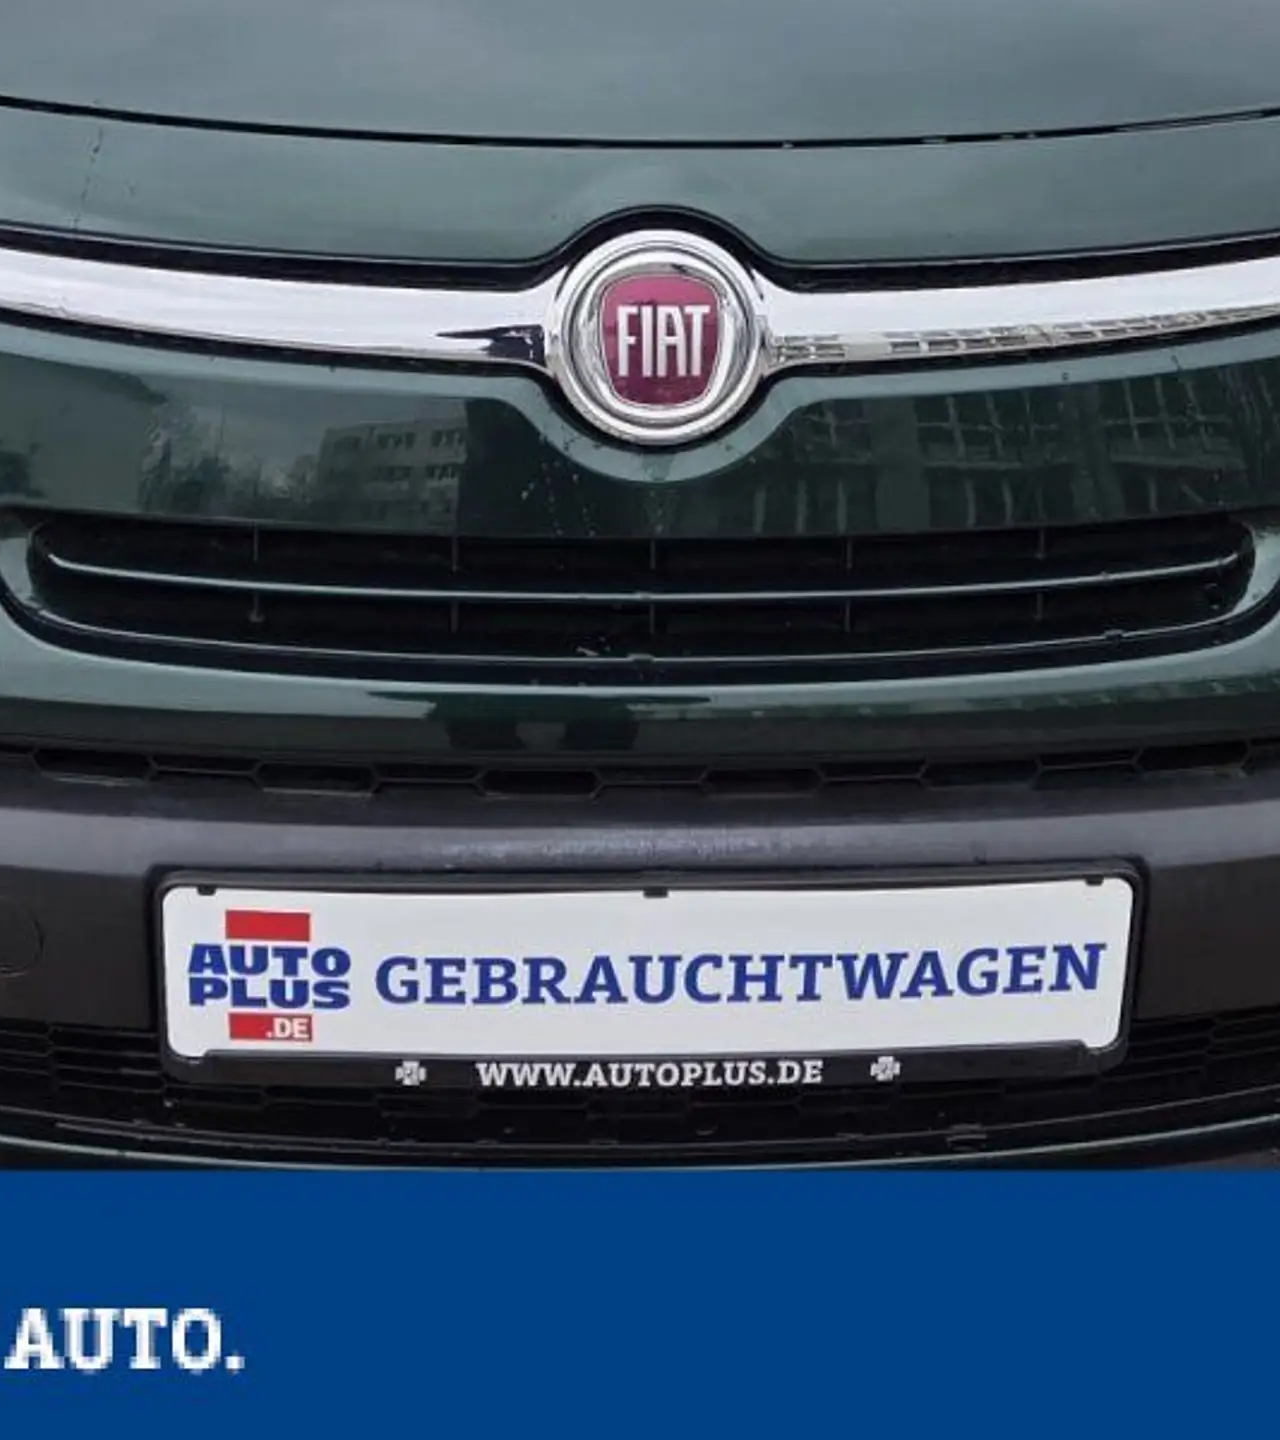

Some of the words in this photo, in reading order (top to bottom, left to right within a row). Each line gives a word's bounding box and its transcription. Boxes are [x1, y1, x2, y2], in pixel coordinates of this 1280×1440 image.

[616, 305, 711, 377] FIAT
[188, 943, 351, 977] AUTO
[375, 943, 1107, 1005] GEBRAUCHTWAGEN
[188, 976, 351, 1009] PLUS
[265, 1016, 310, 1039] .DE
[475, 1059, 824, 1087] WWW.AUTOPLUS.DE
